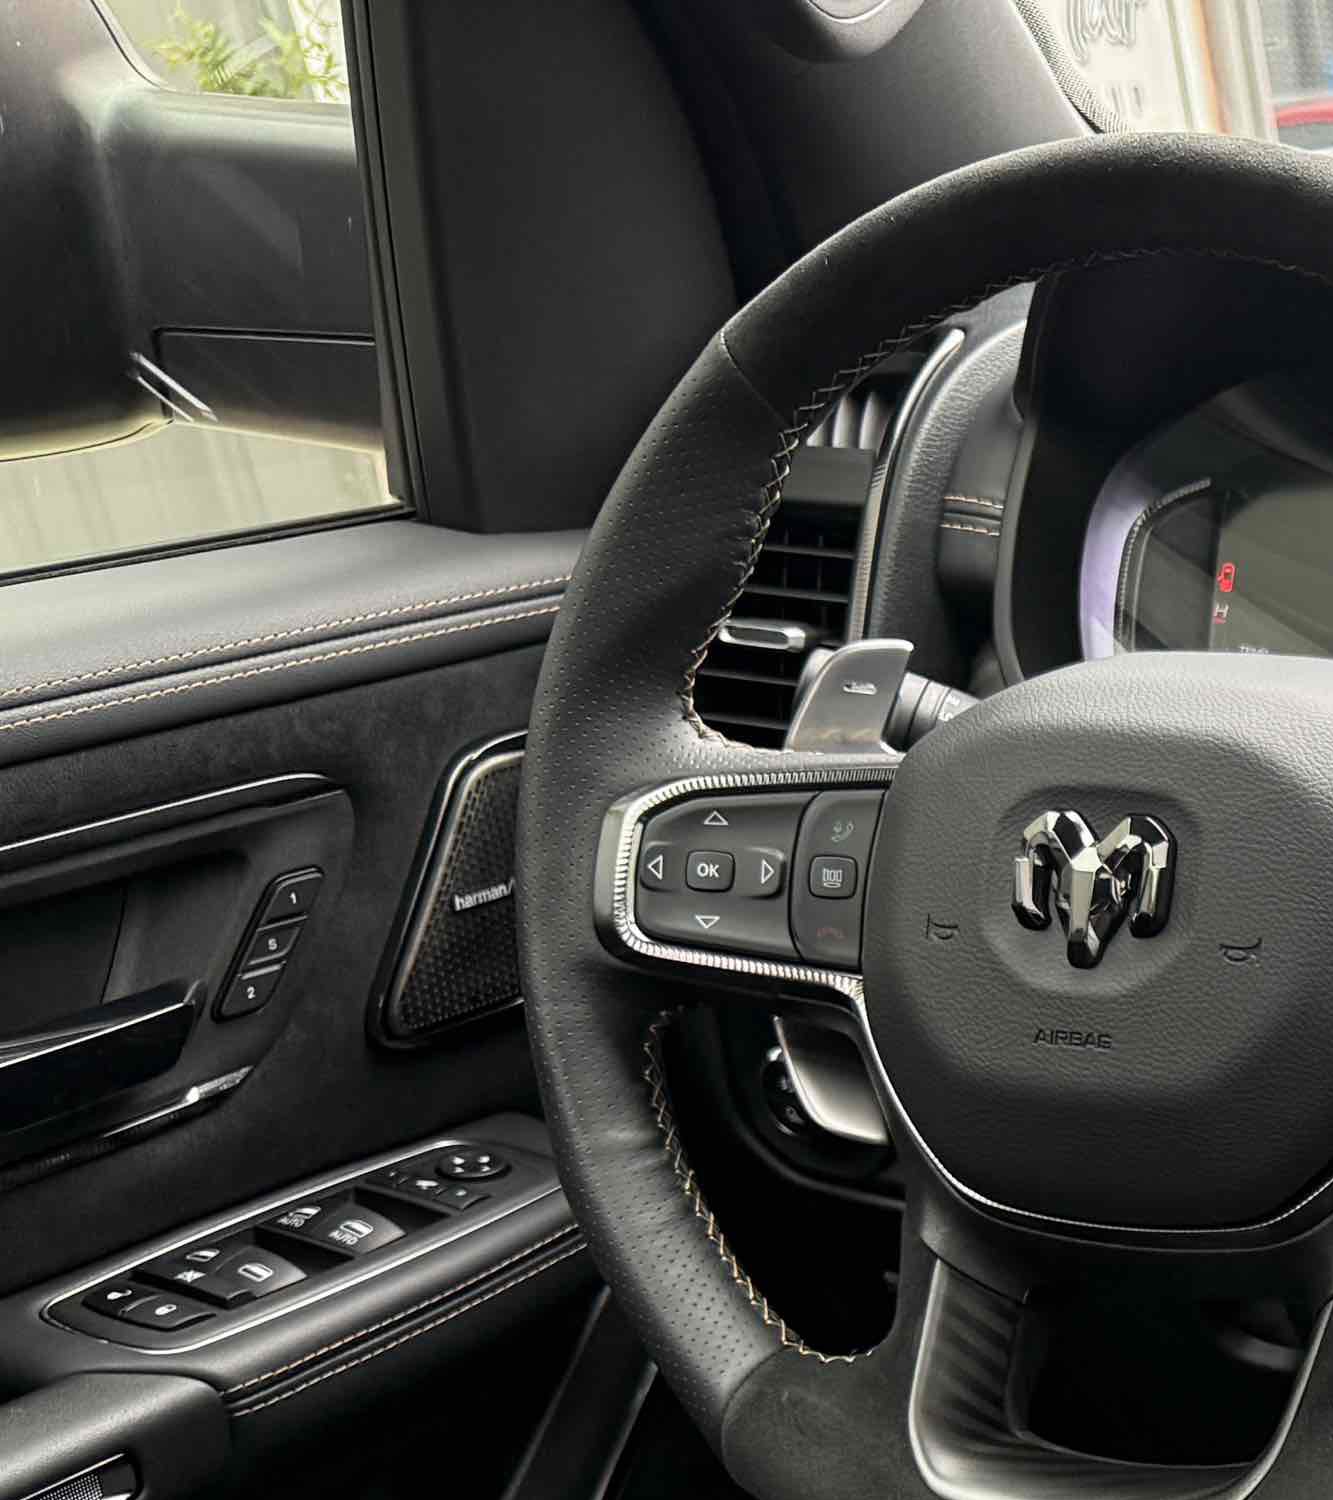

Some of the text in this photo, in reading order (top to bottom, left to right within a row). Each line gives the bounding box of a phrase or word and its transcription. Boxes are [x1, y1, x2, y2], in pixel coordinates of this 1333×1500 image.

[696, 862, 721, 879] OK
[290, 891, 297, 905] 1
[246, 985, 257, 1000] 2
[1032, 1027, 1114, 1050] AIRBAG
